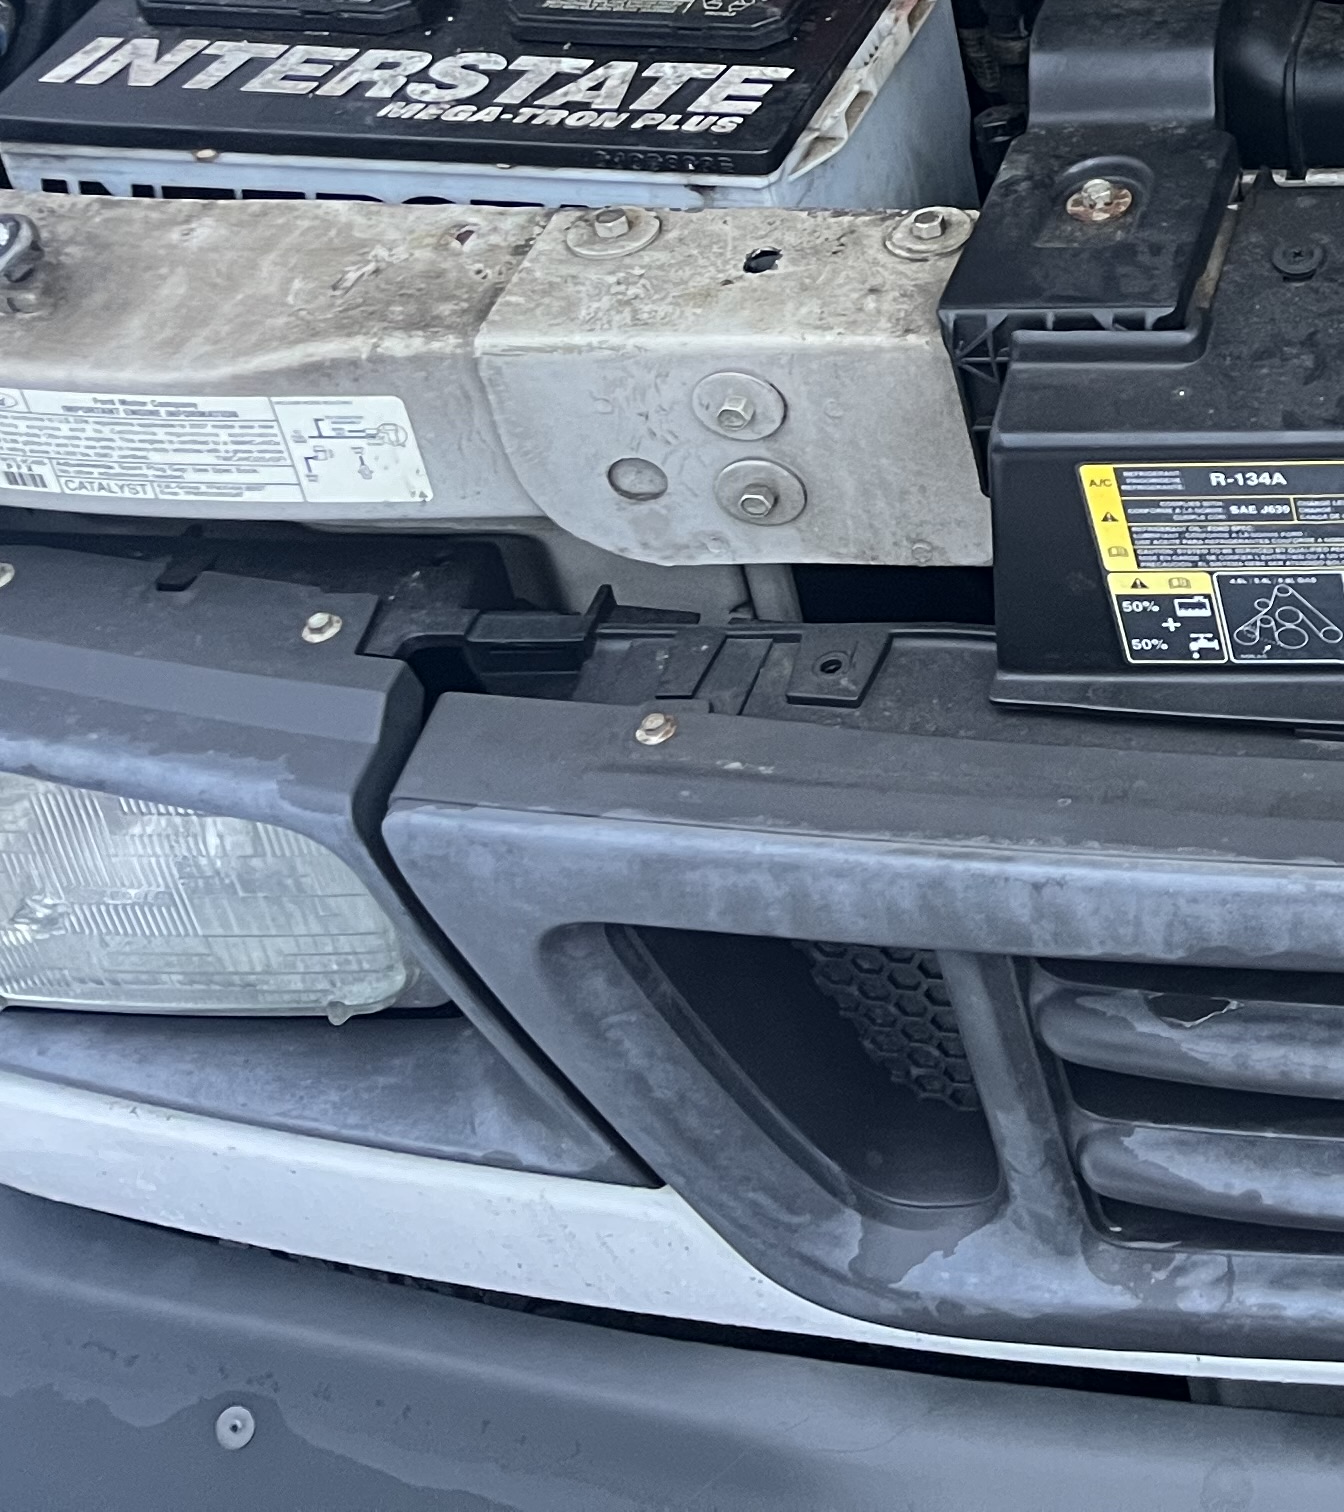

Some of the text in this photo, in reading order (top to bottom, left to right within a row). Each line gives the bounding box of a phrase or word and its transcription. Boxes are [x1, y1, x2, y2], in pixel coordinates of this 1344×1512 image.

[40, 35, 798, 115] INTERSTATE
[376, 100, 746, 134] MEGA-TRON PLUS
[1088, 478, 1113, 488] A/C
[1208, 471, 1288, 487] R-134A
[64, 479, 149, 496] CATALYST
[1229, 505, 1258, 514] SAE
[1260, 504, 1290, 514] J639
[1121, 600, 1160, 612] 50%
[1131, 639, 1169, 651] 50%
